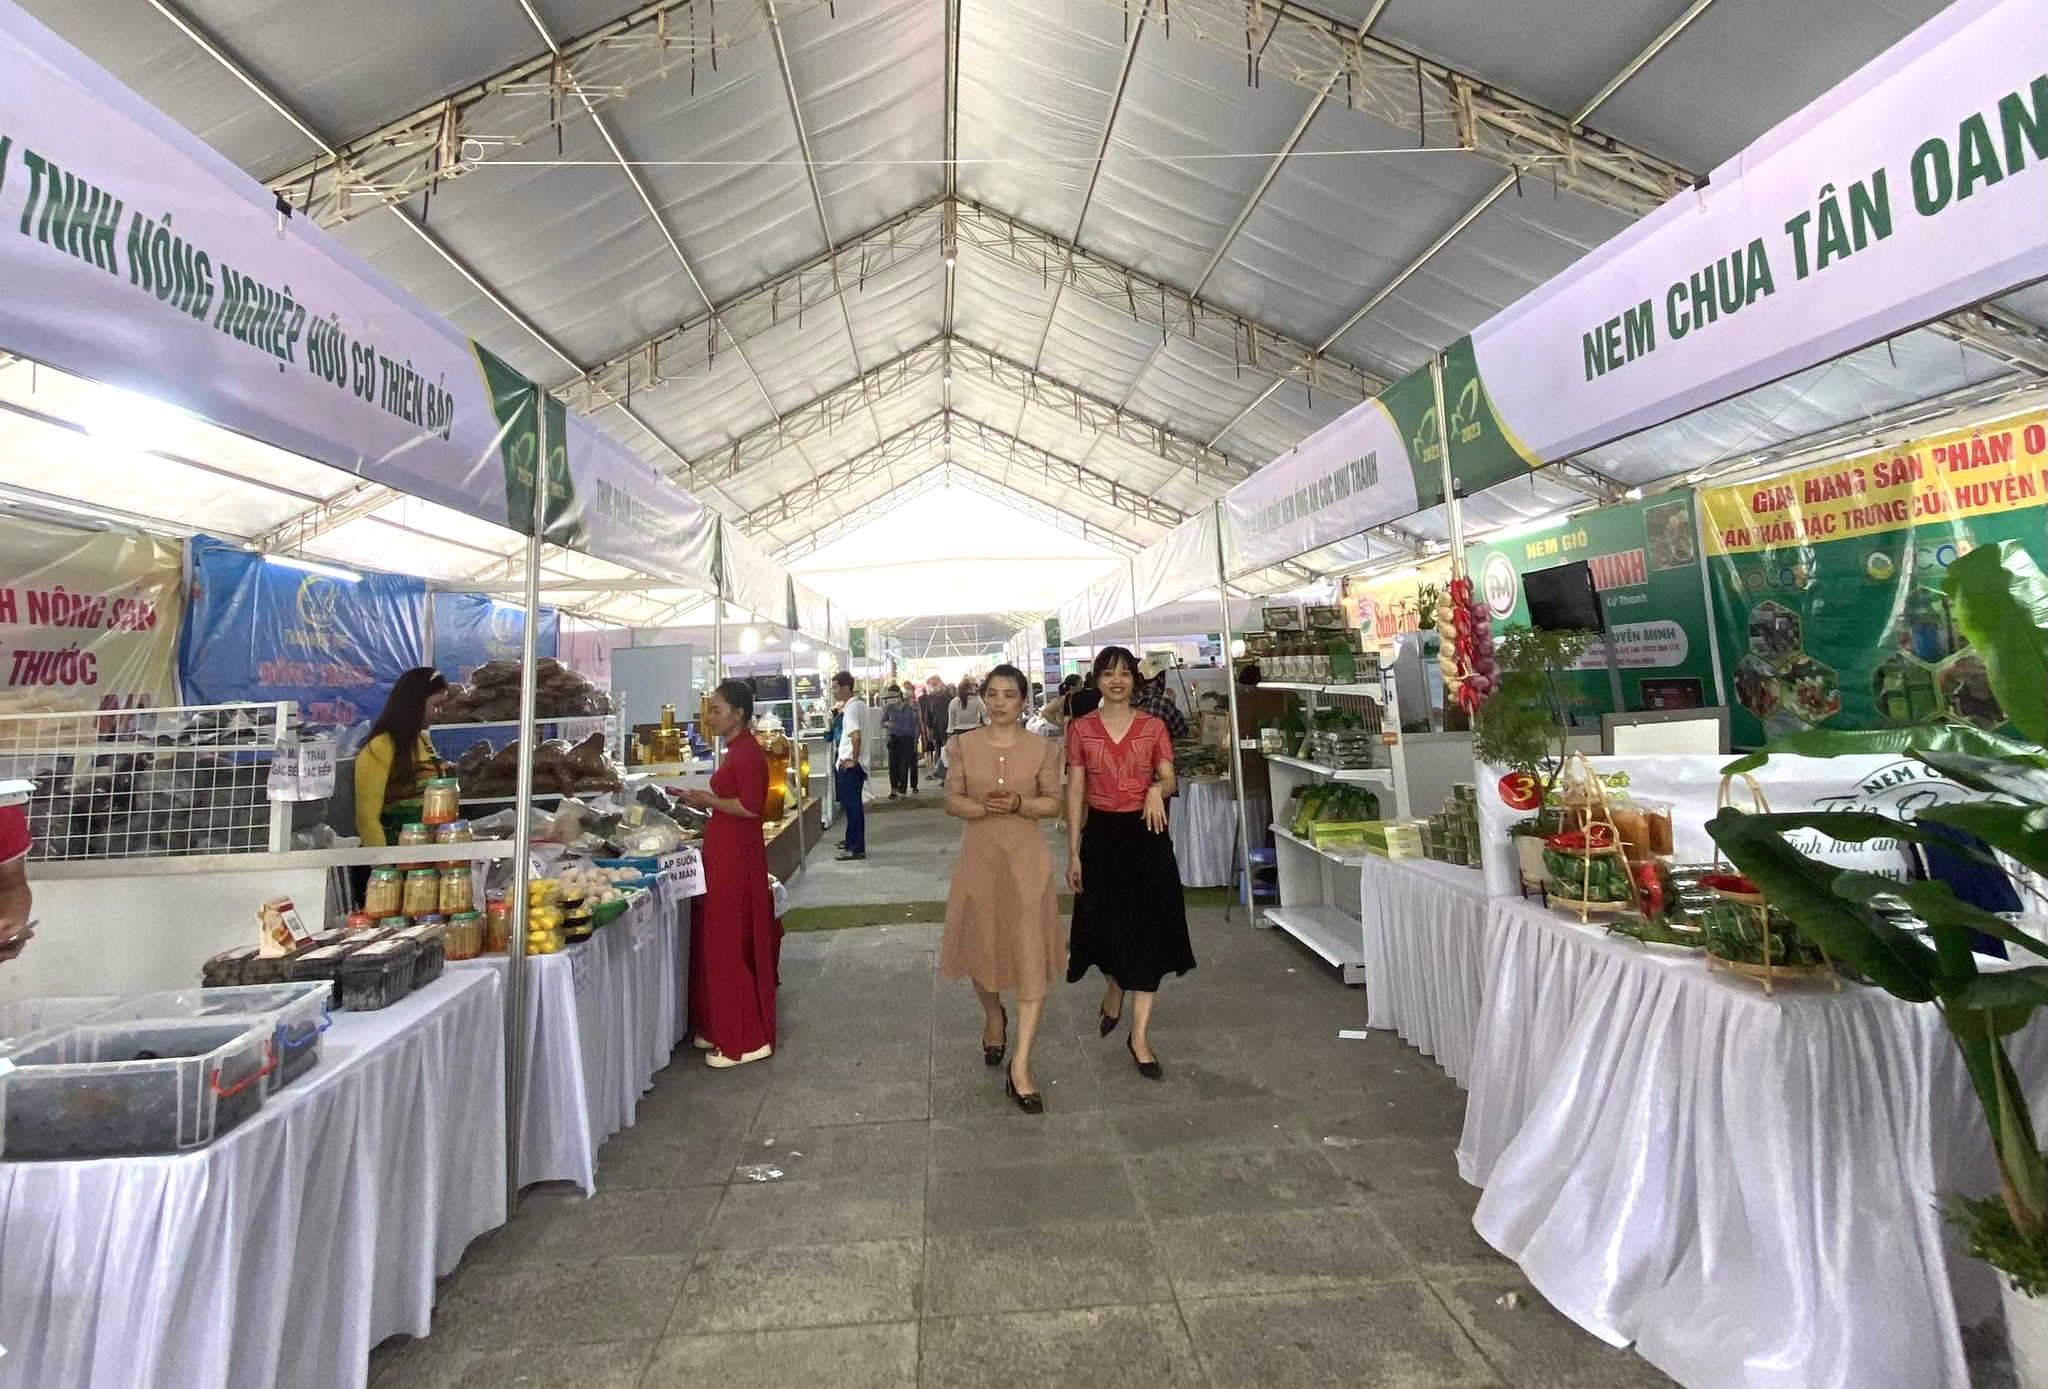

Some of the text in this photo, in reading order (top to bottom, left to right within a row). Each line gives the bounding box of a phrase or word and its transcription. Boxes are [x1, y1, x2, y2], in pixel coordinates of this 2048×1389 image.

[1583, 299, 1656, 382] NEM
[1666, 237, 1775, 341] CHUA
[1784, 166, 1893, 280] TÂN
[19, 149, 123, 276] TNHH
[127, 211, 214, 321] NÔNG
[213, 263, 306, 373] NGHIỆP
[306, 312, 347, 389] HỮU
[351, 341, 376, 403] CƠ
[379, 358, 425, 427] THIÊN
[426, 371, 454, 442] BẢO
[1873, 449, 1924, 490] SẢN
[1931, 428, 2013, 476] PHẨM
[1954, 472, 2037, 509] HUYỆN
[1525, 537, 1559, 560] NEM
[27, 585, 108, 630] NÔNG
[1643, 627, 1676, 642] MINH
[8, 640, 98, 687] THƯỚC
[1512, 776, 1536, 802] 3
[1861, 765, 1916, 795] NEM
